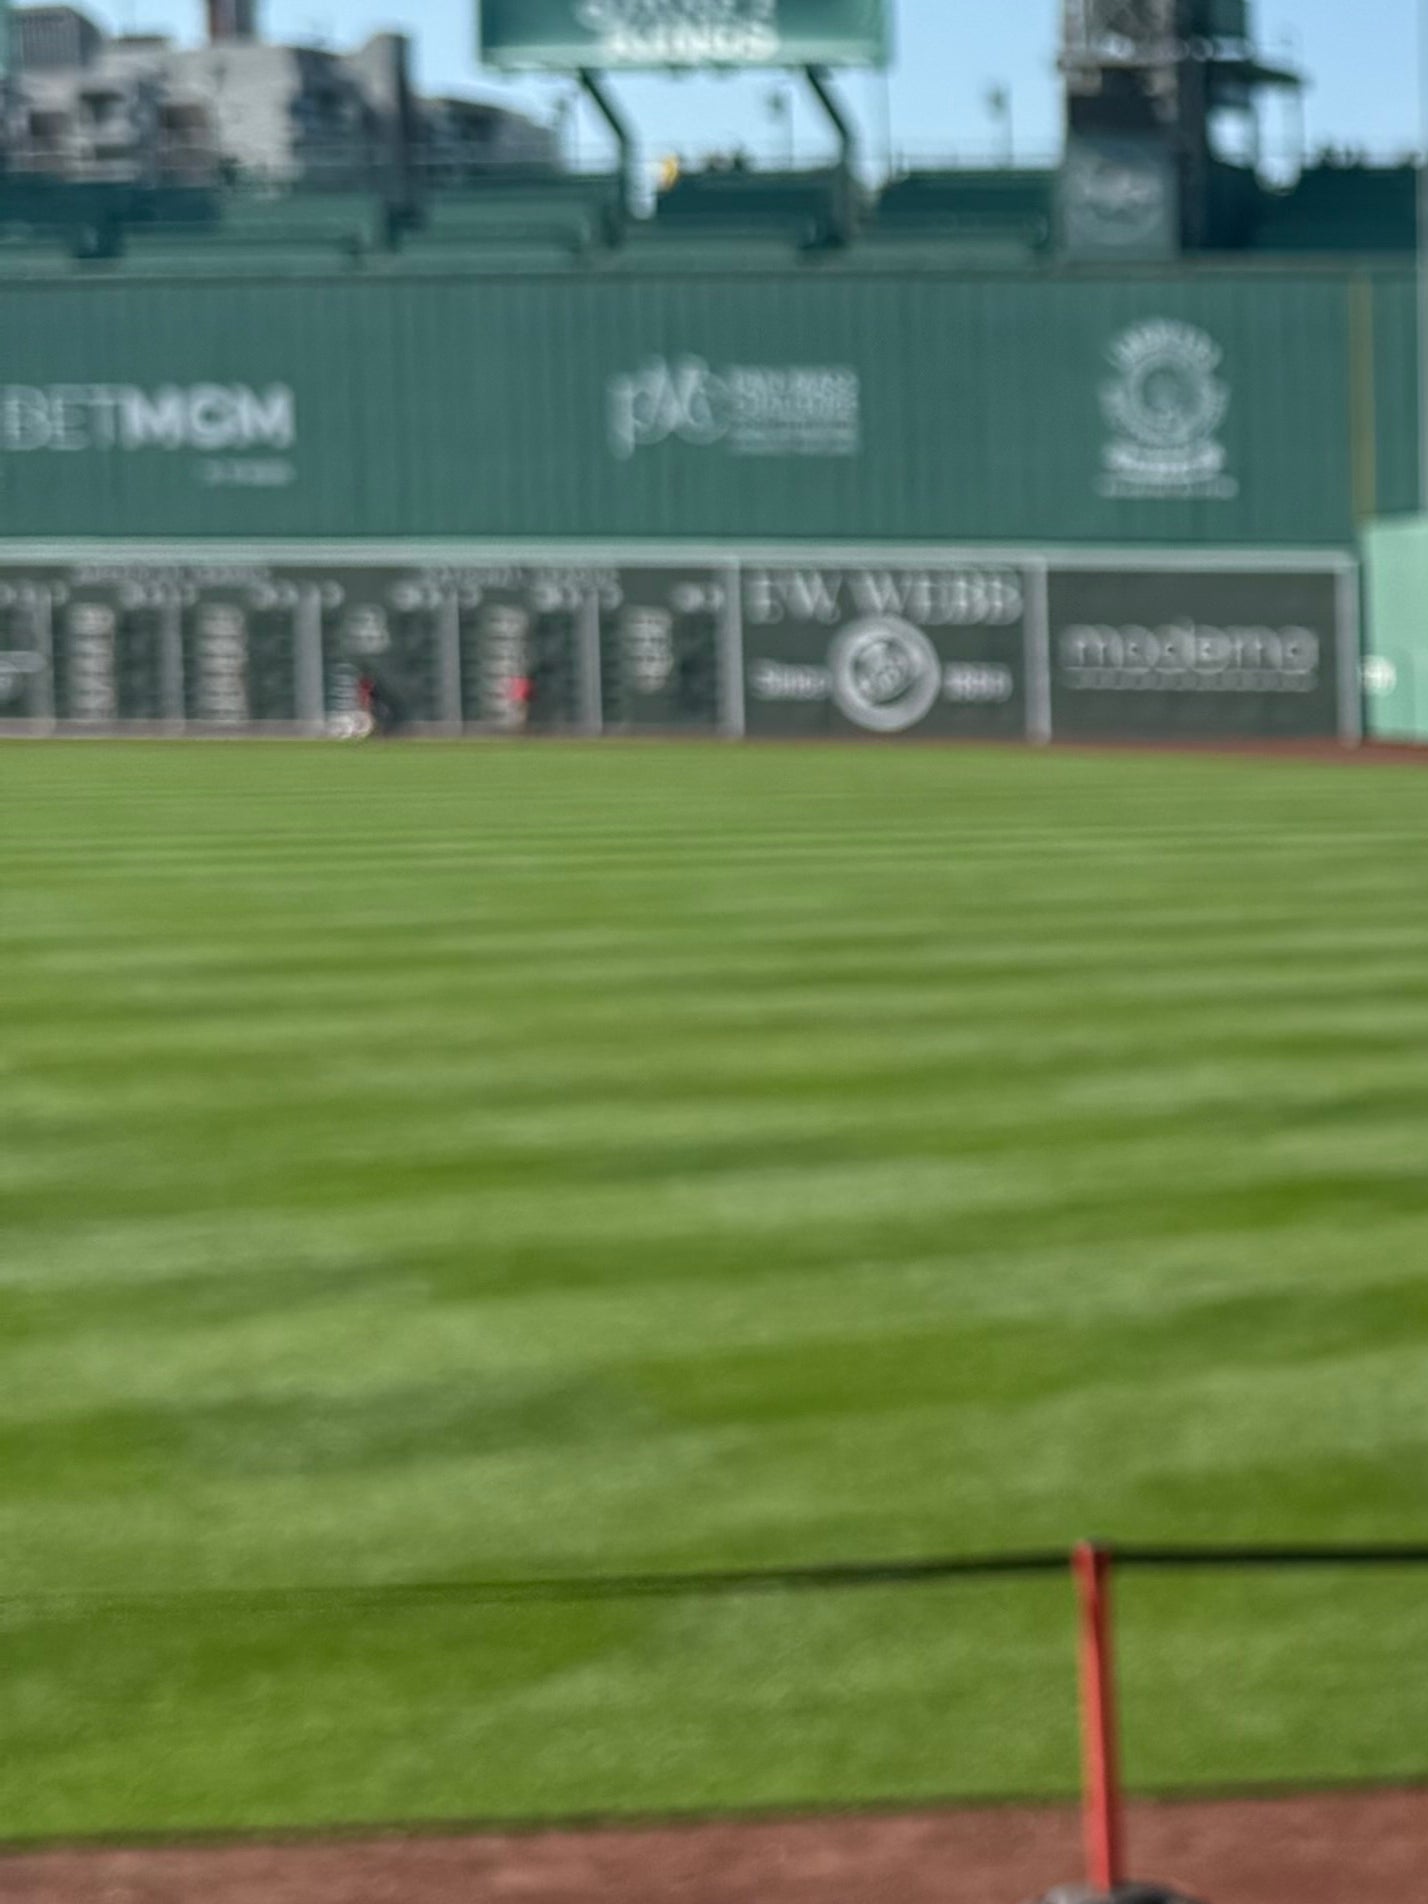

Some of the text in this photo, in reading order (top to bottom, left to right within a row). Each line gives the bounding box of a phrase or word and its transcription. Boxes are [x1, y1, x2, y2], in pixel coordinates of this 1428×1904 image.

[0, 381, 297, 450] BETMGM
[846, 567, 1022, 624] WEBB
[1060, 616, 1320, 674] moderna
